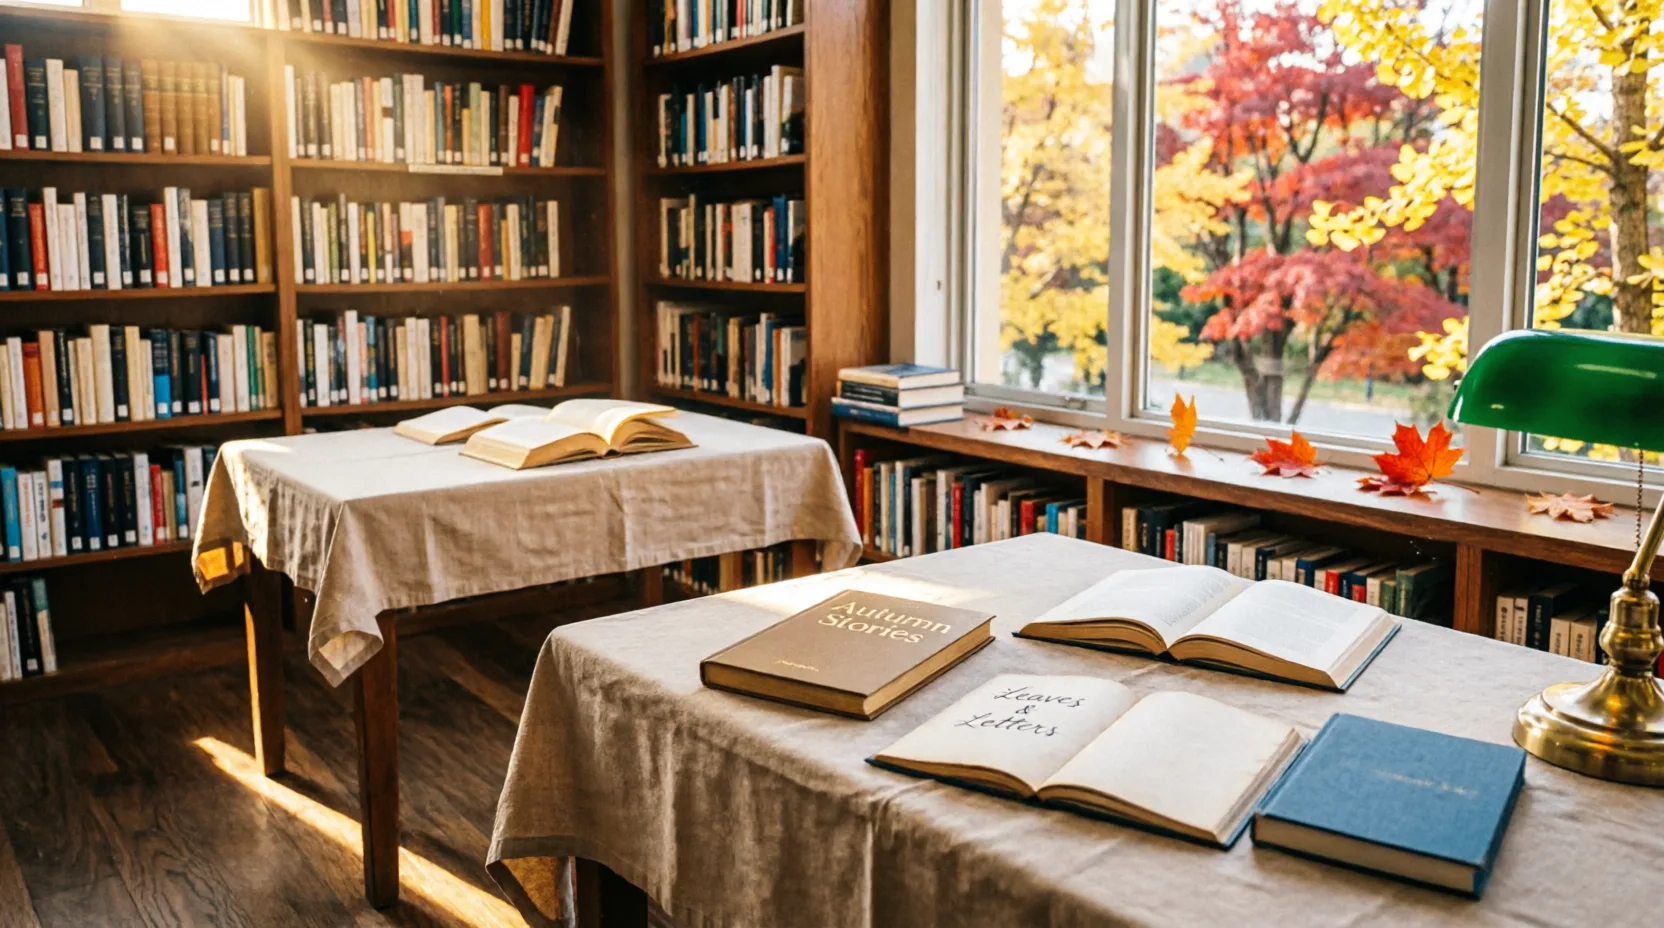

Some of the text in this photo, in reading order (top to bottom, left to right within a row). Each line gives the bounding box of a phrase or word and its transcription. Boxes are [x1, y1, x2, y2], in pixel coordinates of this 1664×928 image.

[817, 613, 924, 643] Stories
[831, 601, 952, 634] Autumn
[993, 686, 1085, 708] Leaves
[1015, 704, 1036, 715] &
[954, 712, 1059, 736] Letters
